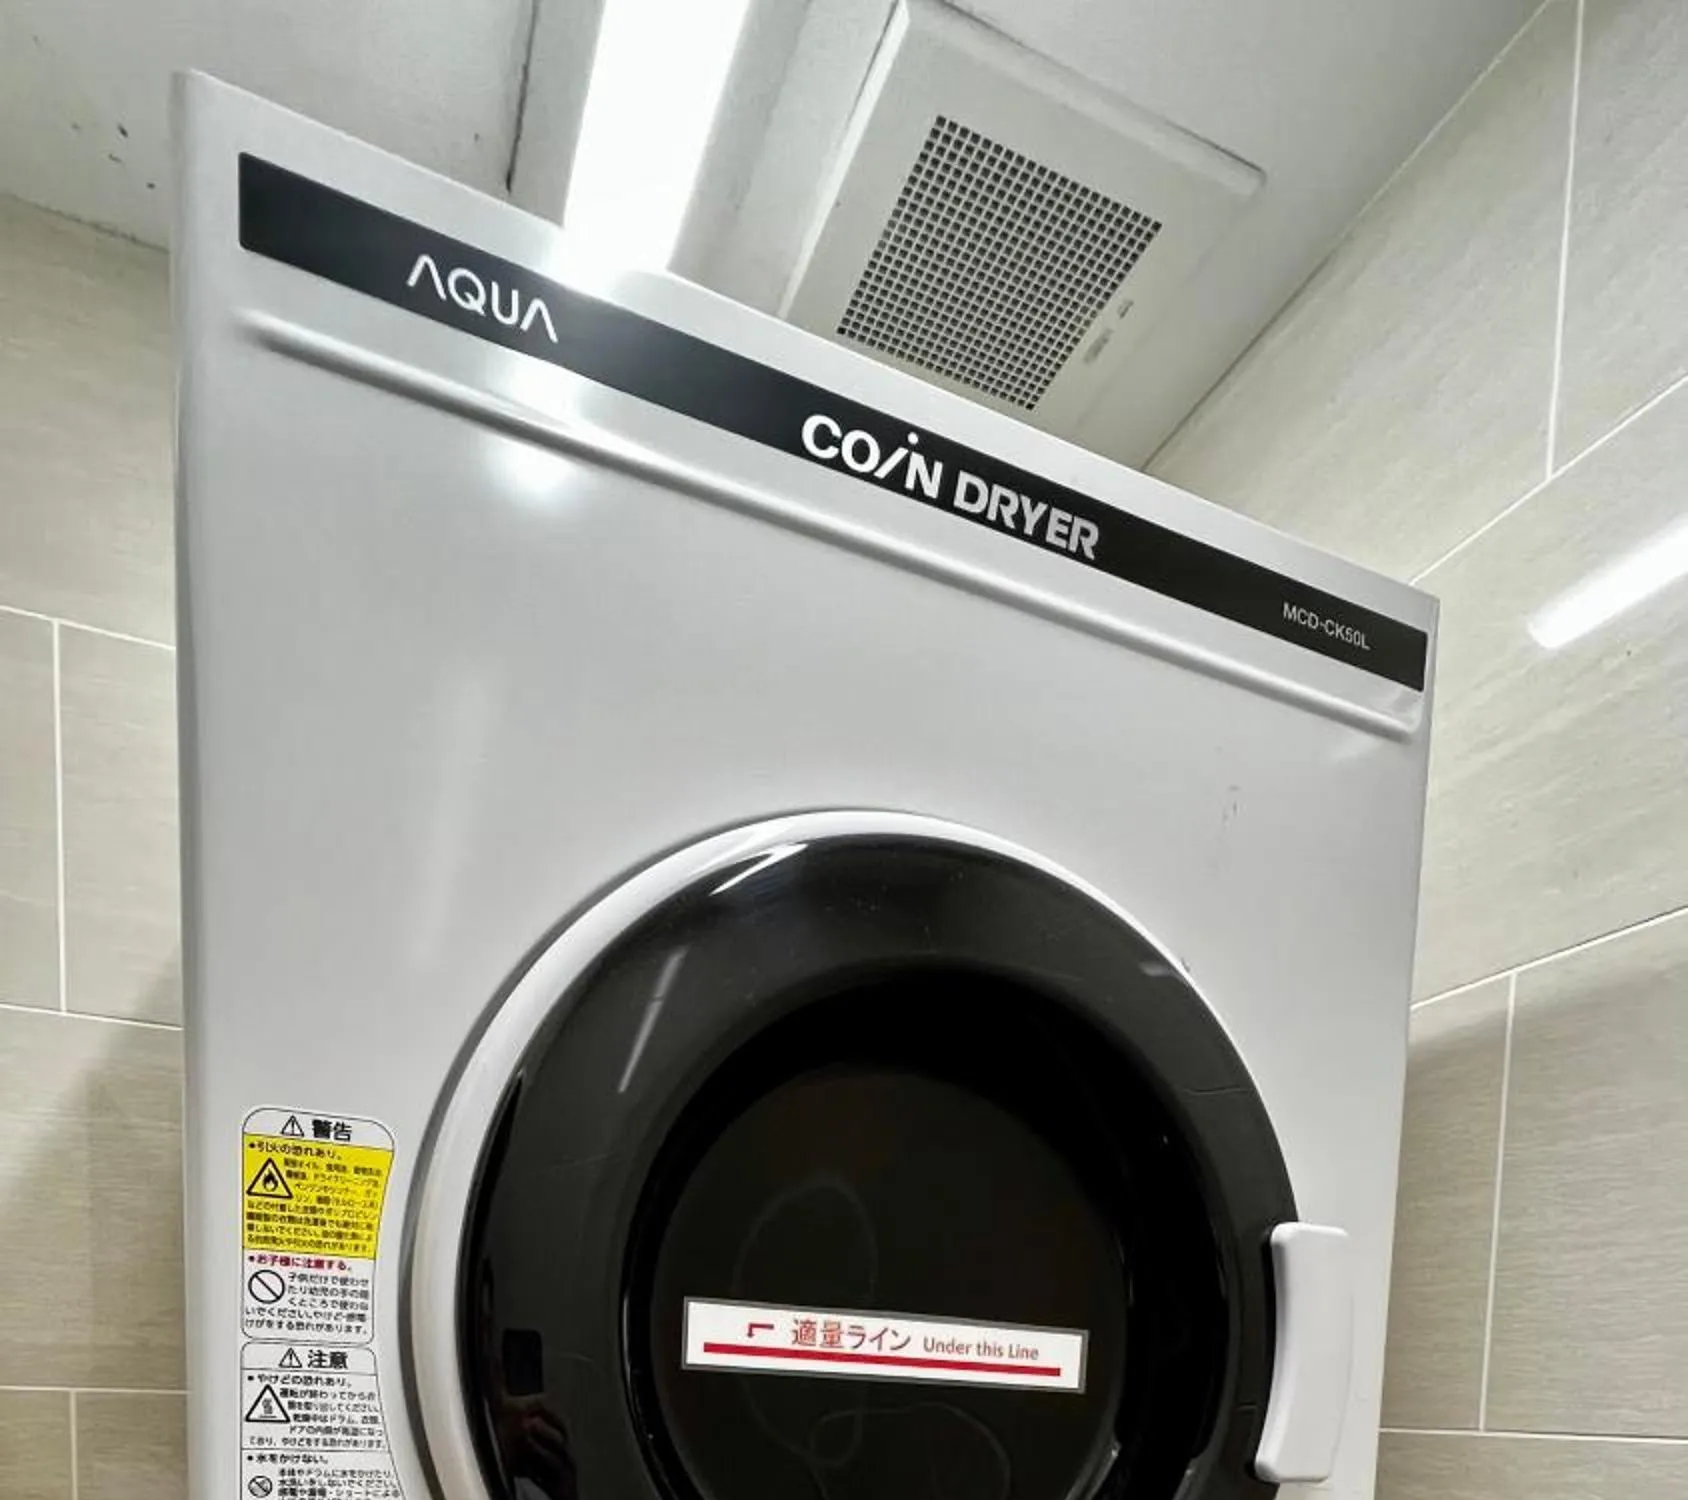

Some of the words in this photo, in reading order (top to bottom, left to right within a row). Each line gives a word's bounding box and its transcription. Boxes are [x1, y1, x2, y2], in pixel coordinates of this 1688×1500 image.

[407, 253, 559, 343] AQUA
[954, 473, 1100, 561] DRYER
[1282, 601, 1371, 650] MCD-CK50L
[312, 1119, 352, 1142] 警告
[308, 1349, 349, 1369] 注意
[791, 1318, 911, 1352] 適量ライン
[922, 1336, 971, 1355] Under
[975, 1341, 1004, 1358] this
[1008, 1343, 1040, 1361] Line
